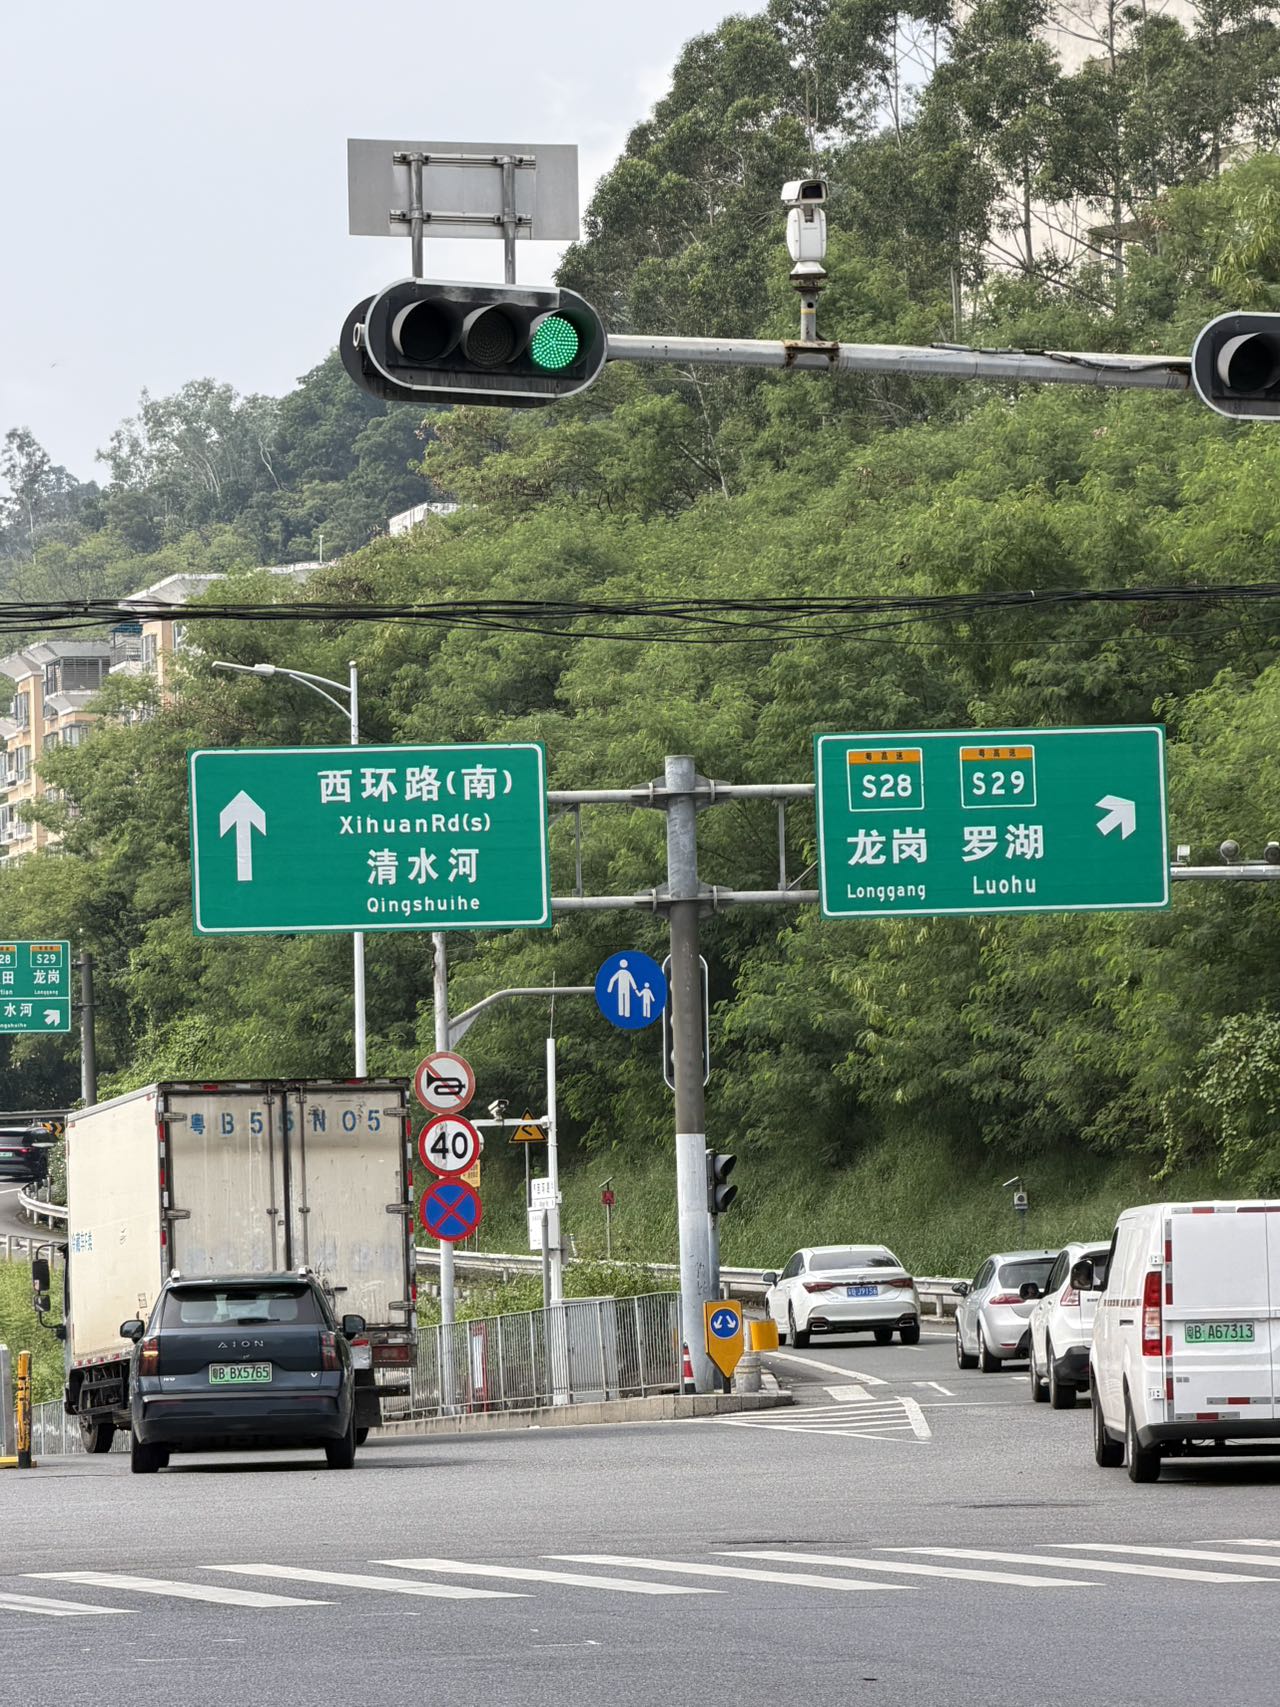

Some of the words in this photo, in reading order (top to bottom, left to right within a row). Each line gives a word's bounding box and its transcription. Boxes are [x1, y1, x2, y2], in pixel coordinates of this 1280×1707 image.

[862, 773, 913, 799] S28
[972, 771, 1025, 795] S29
[847, 826, 927, 866] 龙岗
[961, 823, 1045, 862] 罗湖
[367, 847, 480, 886] 清水河
[847, 882, 926, 902] Longgang
[972, 875, 1037, 895] Luohu
[366, 896, 480, 917] Qingshuihe
[36, 954, 56, 964] S29
[33, 969, 60, 985] 龙岗
[431, 1131, 468, 1160] 40
[218, 1340, 264, 1349] AION
